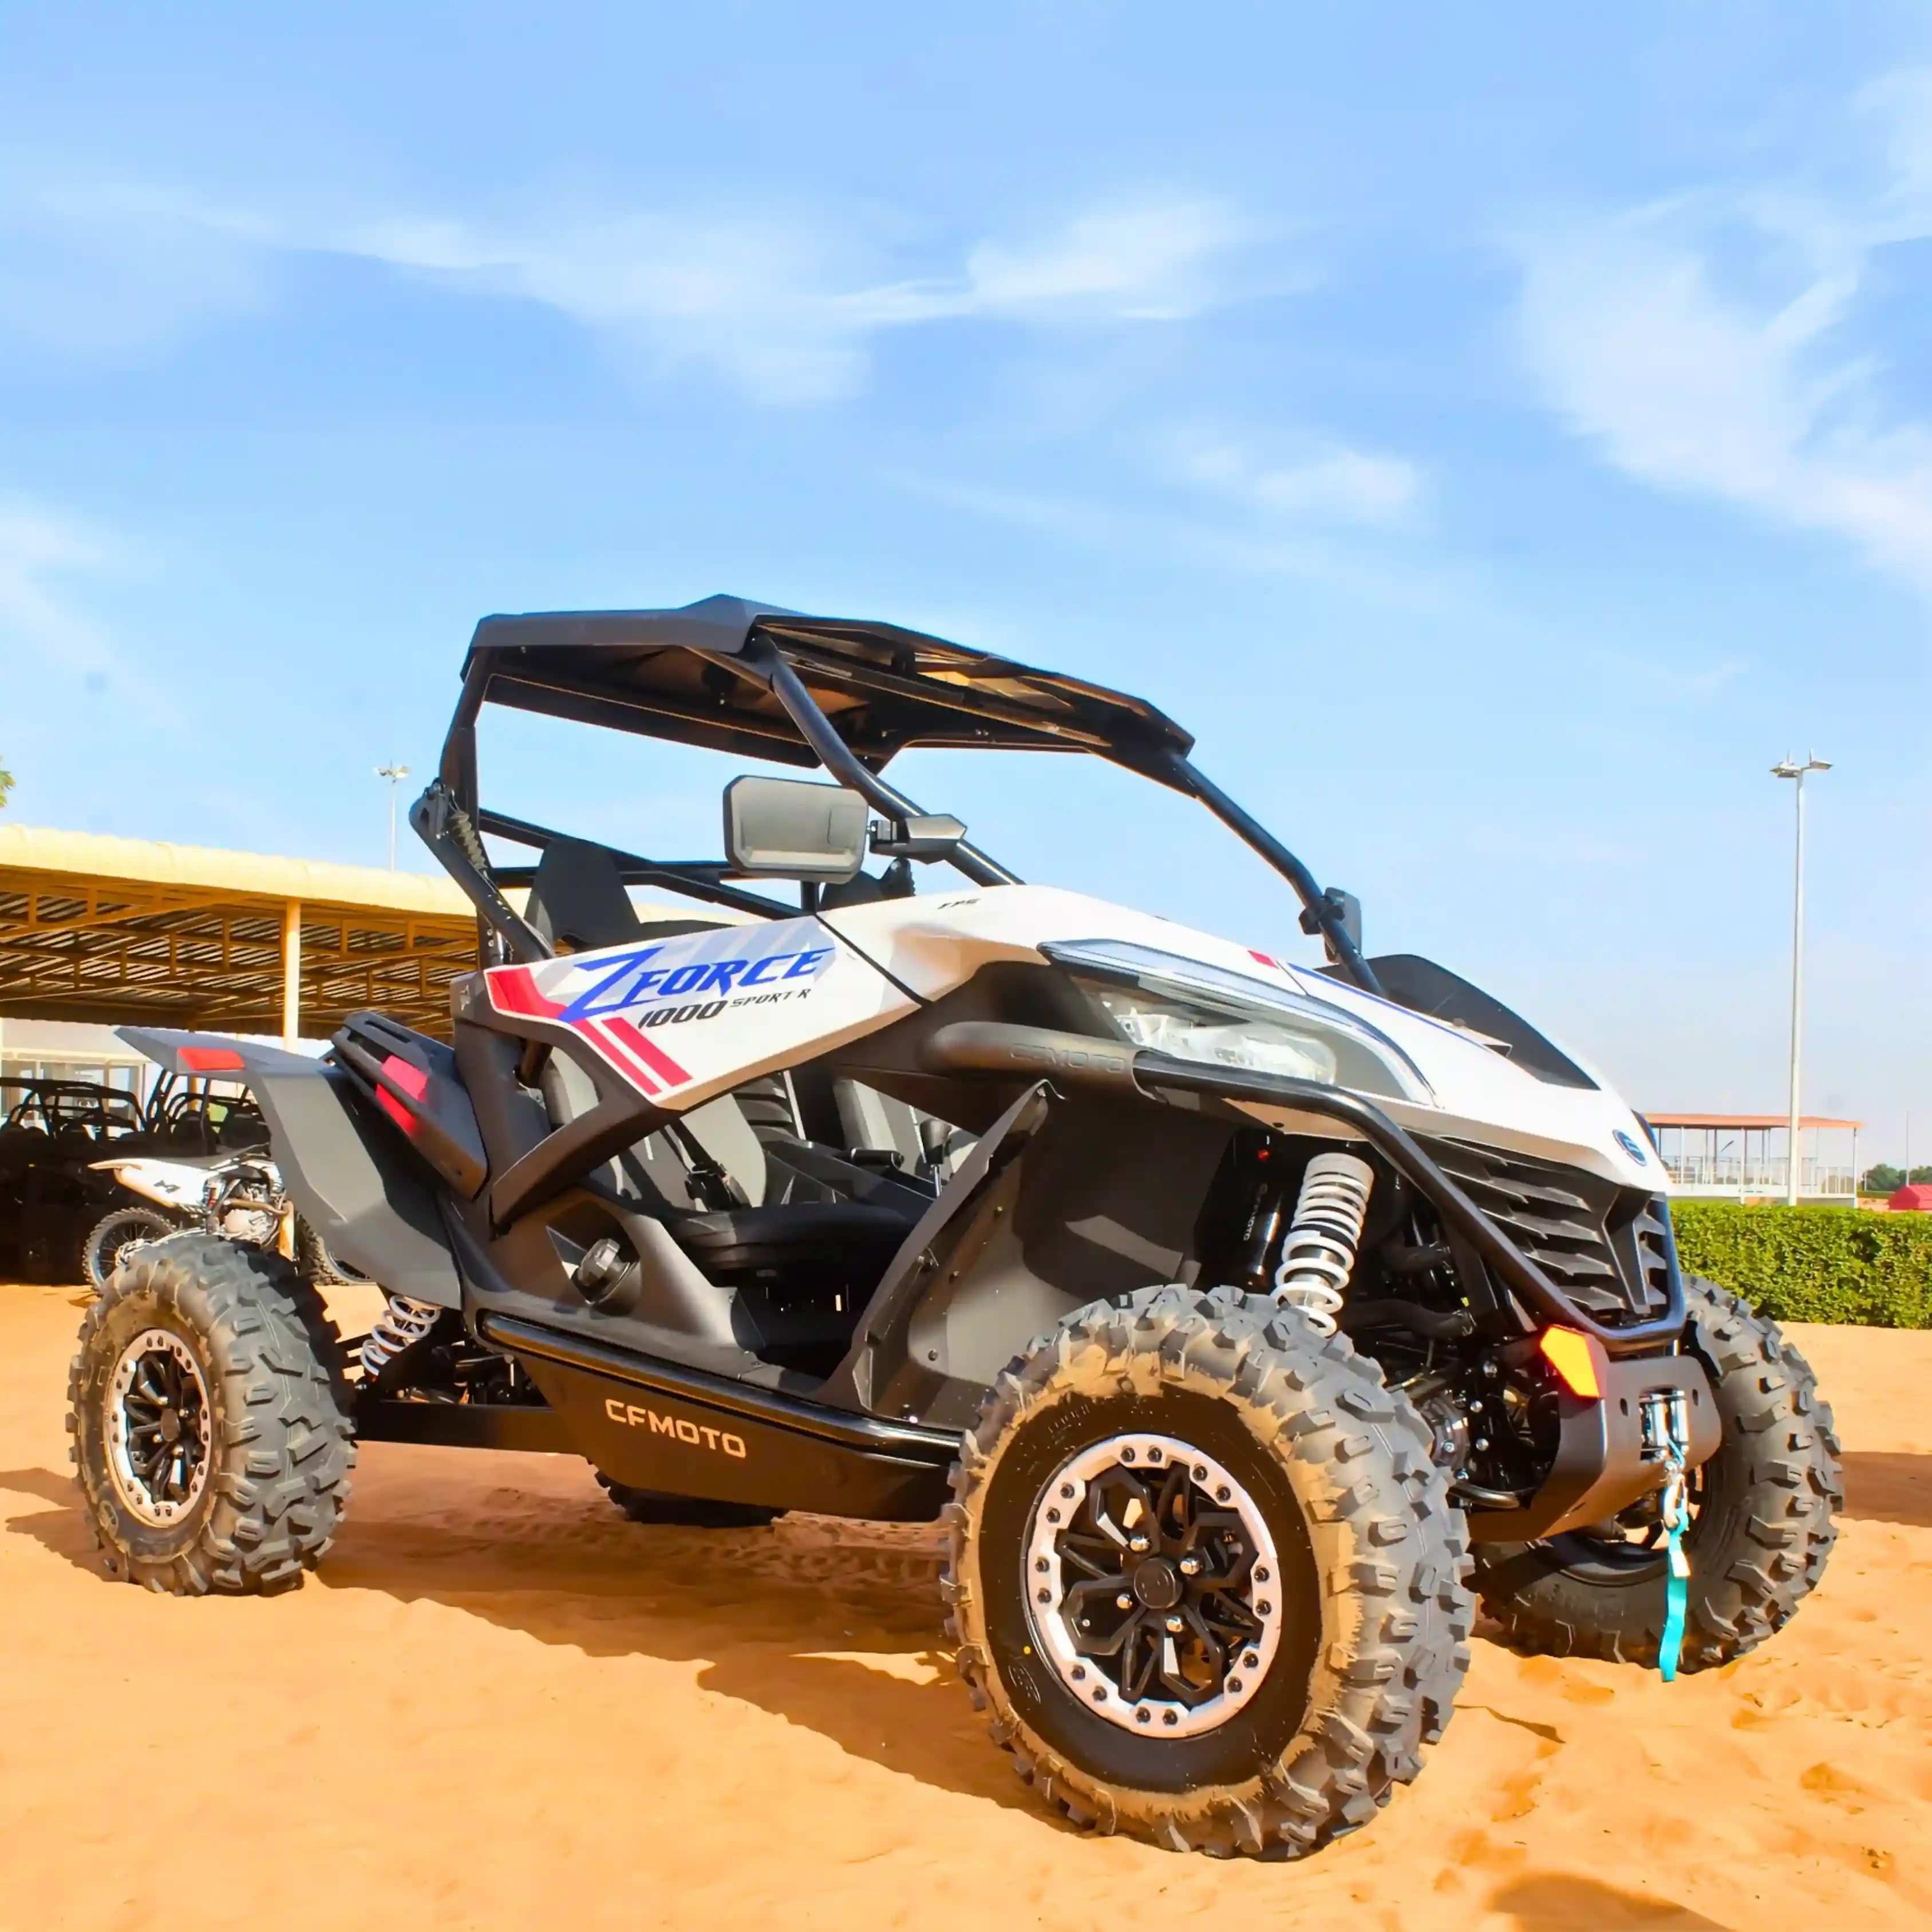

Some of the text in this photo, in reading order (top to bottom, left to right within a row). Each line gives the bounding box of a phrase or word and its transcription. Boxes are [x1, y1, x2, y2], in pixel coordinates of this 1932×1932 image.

[638, 989, 811, 1029] 1000 SPORT R
[605, 1399, 746, 1458] CFMOTO
